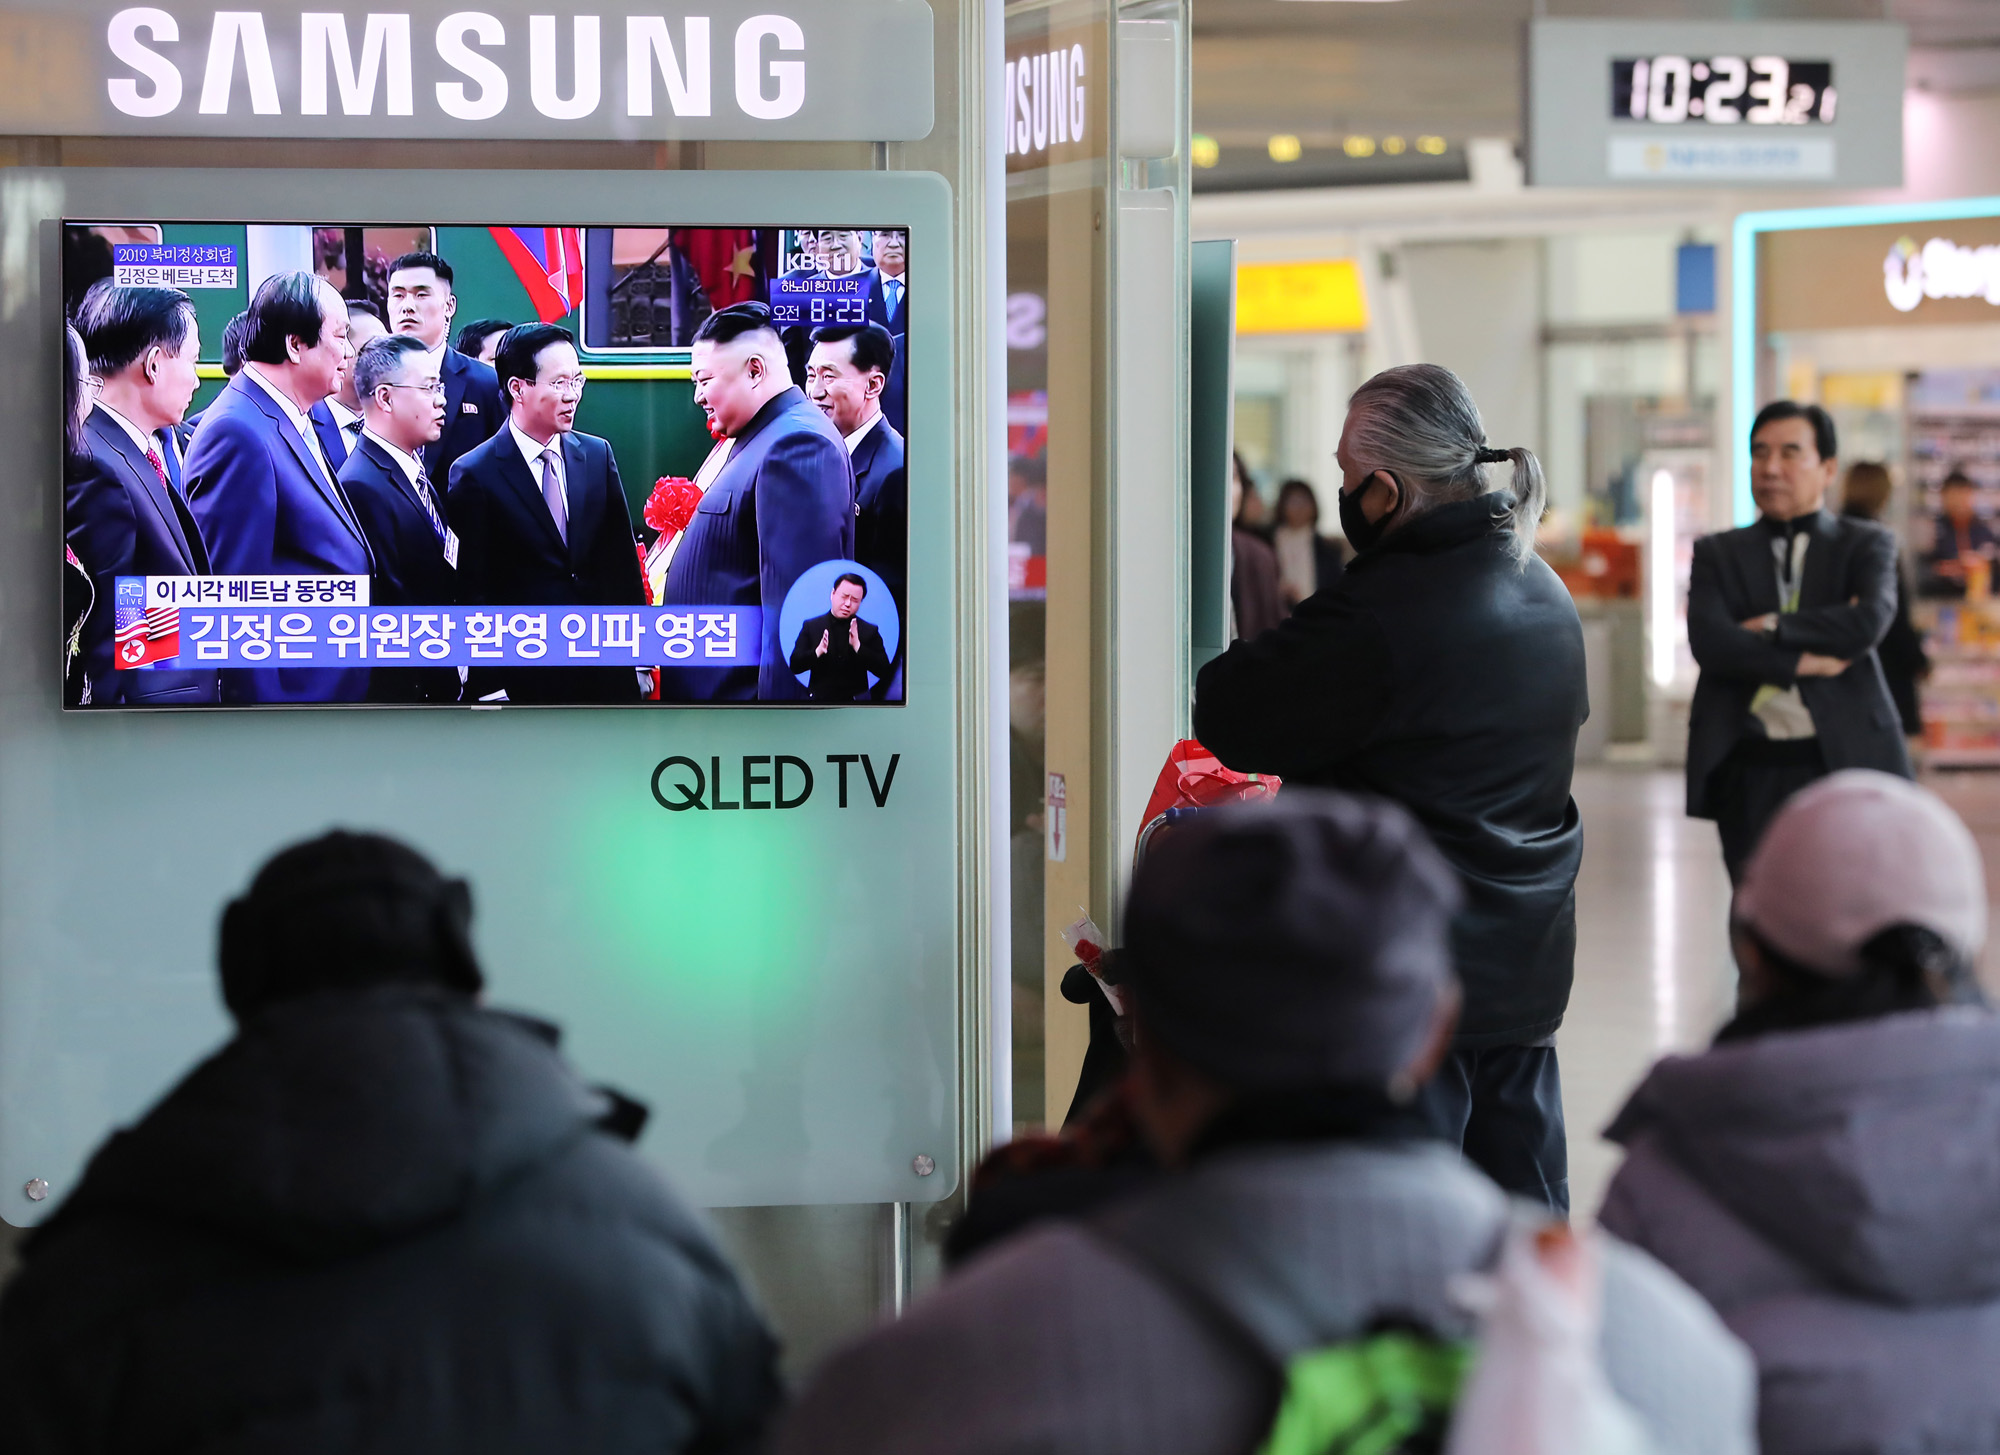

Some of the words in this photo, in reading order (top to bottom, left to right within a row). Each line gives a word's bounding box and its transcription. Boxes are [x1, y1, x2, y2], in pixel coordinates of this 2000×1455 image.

[107, 7, 806, 121] SAMSUNG
[118, 248, 148, 262] 2019
[150, 246, 233, 263] 북미정상회담
[118, 268, 160, 285] 김정은
[162, 268, 204, 285] 베트남
[206, 268, 234, 286] 도착
[781, 279, 813, 293] 하노이
[814, 280, 836, 293] 현지
[837, 280, 859, 293] 시각
[772, 305, 800, 322] 오전
[810, 298, 865, 323] 8:23
[119, 598, 143, 606] LIVE
[156, 580, 176, 603] 이
[181, 580, 224, 603] 시각
[228, 580, 291, 603] 베트남
[294, 580, 356, 603] 동당역
[188, 613, 317, 661] 김정은
[326, 613, 457, 660] 위원장
[464, 612, 548, 659] 환영
[560, 613, 646, 658] 인파
[655, 613, 738, 659] 영접
[650, 755, 814, 812] QLED
[826, 753, 901, 809] TV
